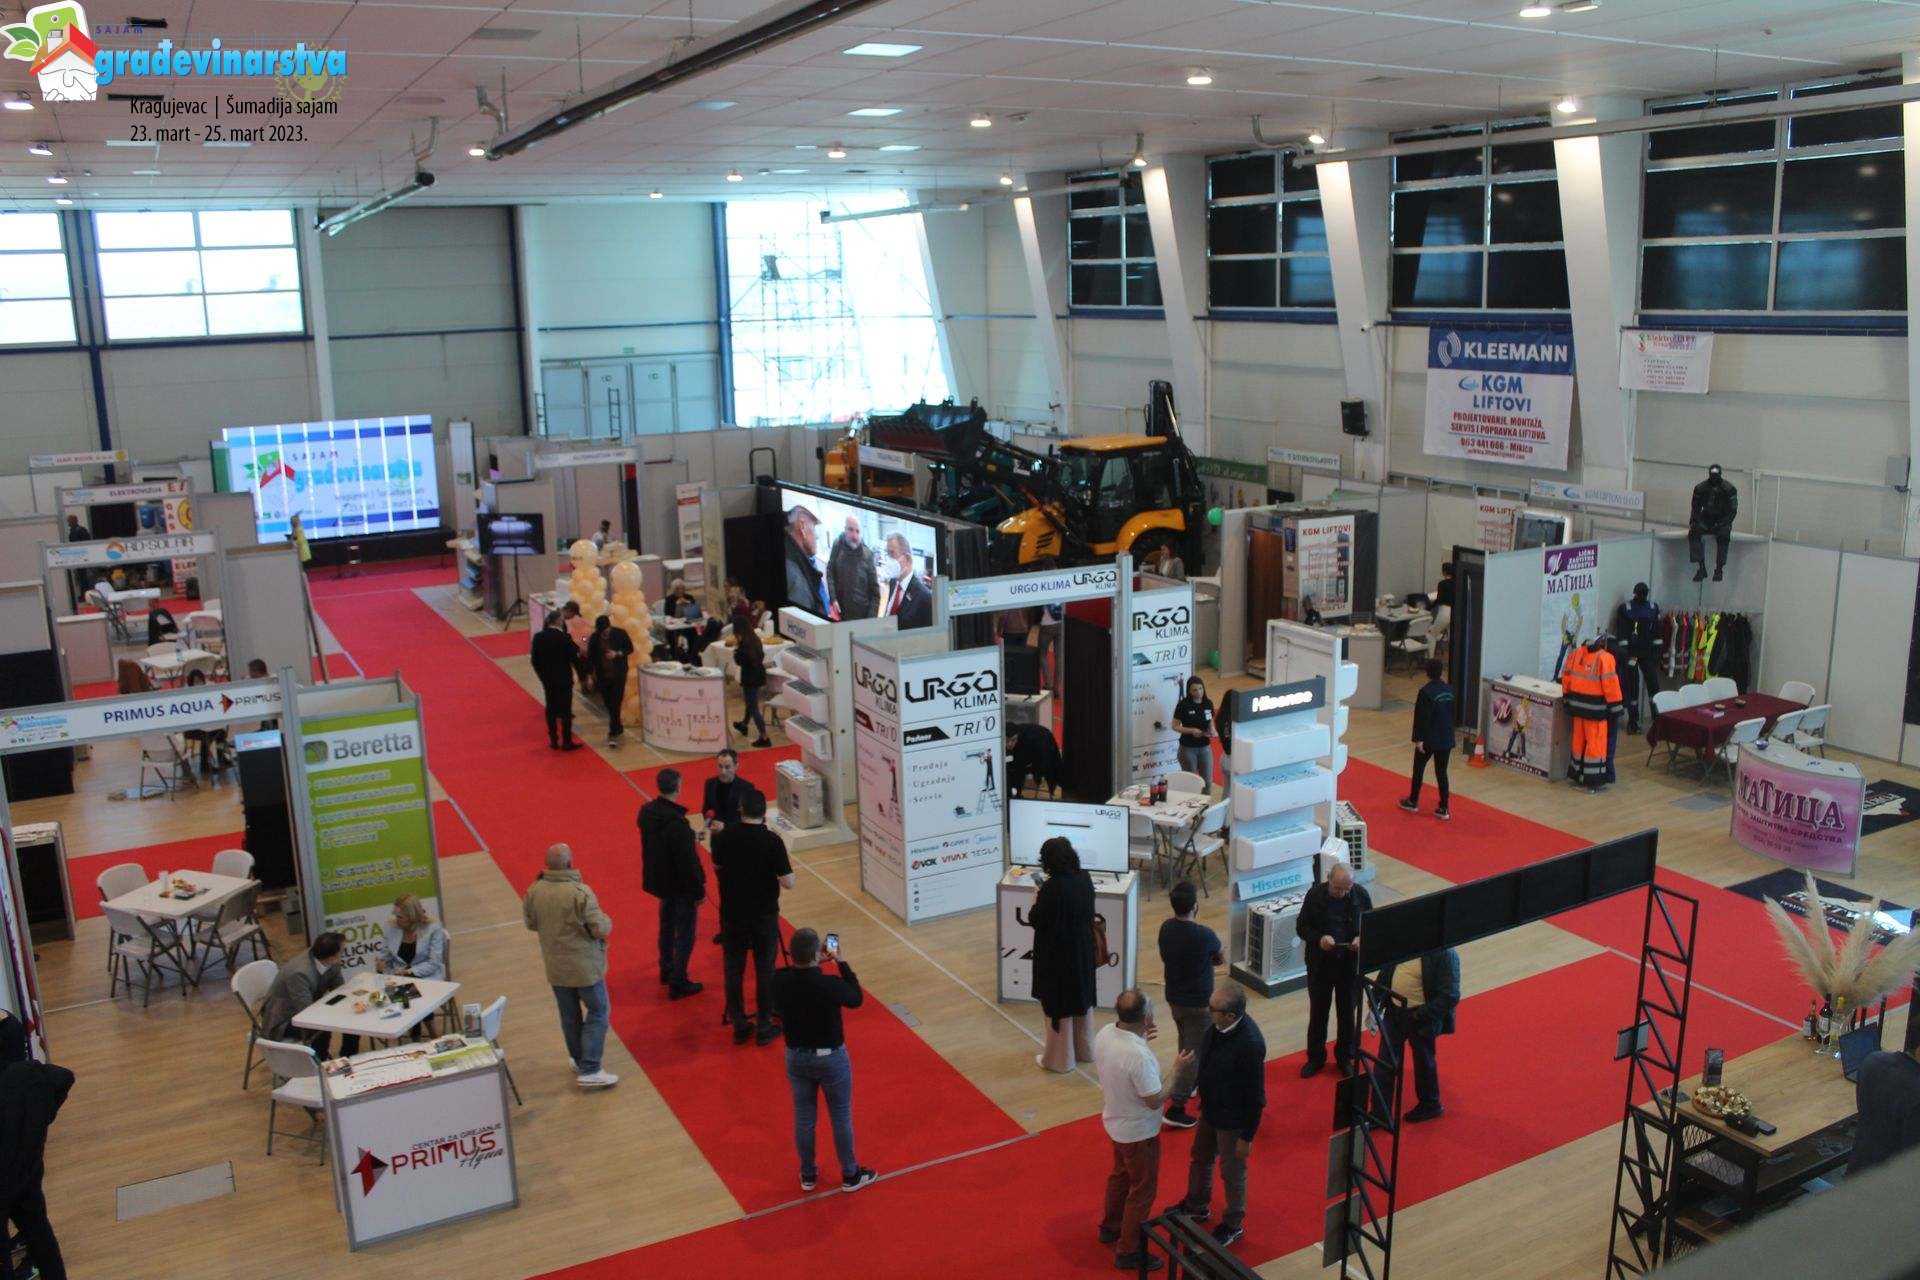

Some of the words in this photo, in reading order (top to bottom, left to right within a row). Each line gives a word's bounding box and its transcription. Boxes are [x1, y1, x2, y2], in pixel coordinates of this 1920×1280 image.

[1464, 341, 1568, 363] KLEEMANN
[1481, 374, 1523, 394] KGM
[1473, 395, 1532, 413] LIFTOVI
[1450, 422, 1475, 434] SERVIS
[1480, 424, 1518, 438] POPRAVKA
[1519, 429, 1546, 441] LIFTOVA
[291, 450, 339, 461] SAJAM
[1302, 526, 1320, 536] KGM
[1322, 523, 1351, 535] LIFTOVI
[1010, 583, 1039, 595] URGO
[1041, 580, 1071, 592] KLIMA
[1073, 571, 1117, 585] URGO
[1095, 582, 1117, 590] KLIMA
[1132, 606, 1190, 632] RGO
[1155, 625, 1190, 640] KLIMA
[854, 661, 897, 703] URGO
[904, 669, 998, 704] URGO
[103, 703, 166, 724] PRIMUS
[169, 699, 214, 716] AQUA
[235, 692, 281, 707] PRIMUS
[953, 693, 998, 710] KLIMA
[334, 733, 413, 760] Beretta
[912, 762, 948, 773] Prodaja
[912, 775, 956, 788] Ugradnja
[913, 793, 943, 804] Servis
[941, 852, 968, 864] VIVAX
[1251, 873, 1302, 894] Hisense
[412, 1136, 446, 1150] CENTAR
[447, 1134, 458, 1142] ZA
[459, 1122, 503, 1138] GREJANJE
[391, 1131, 496, 1175] PRIMUS
